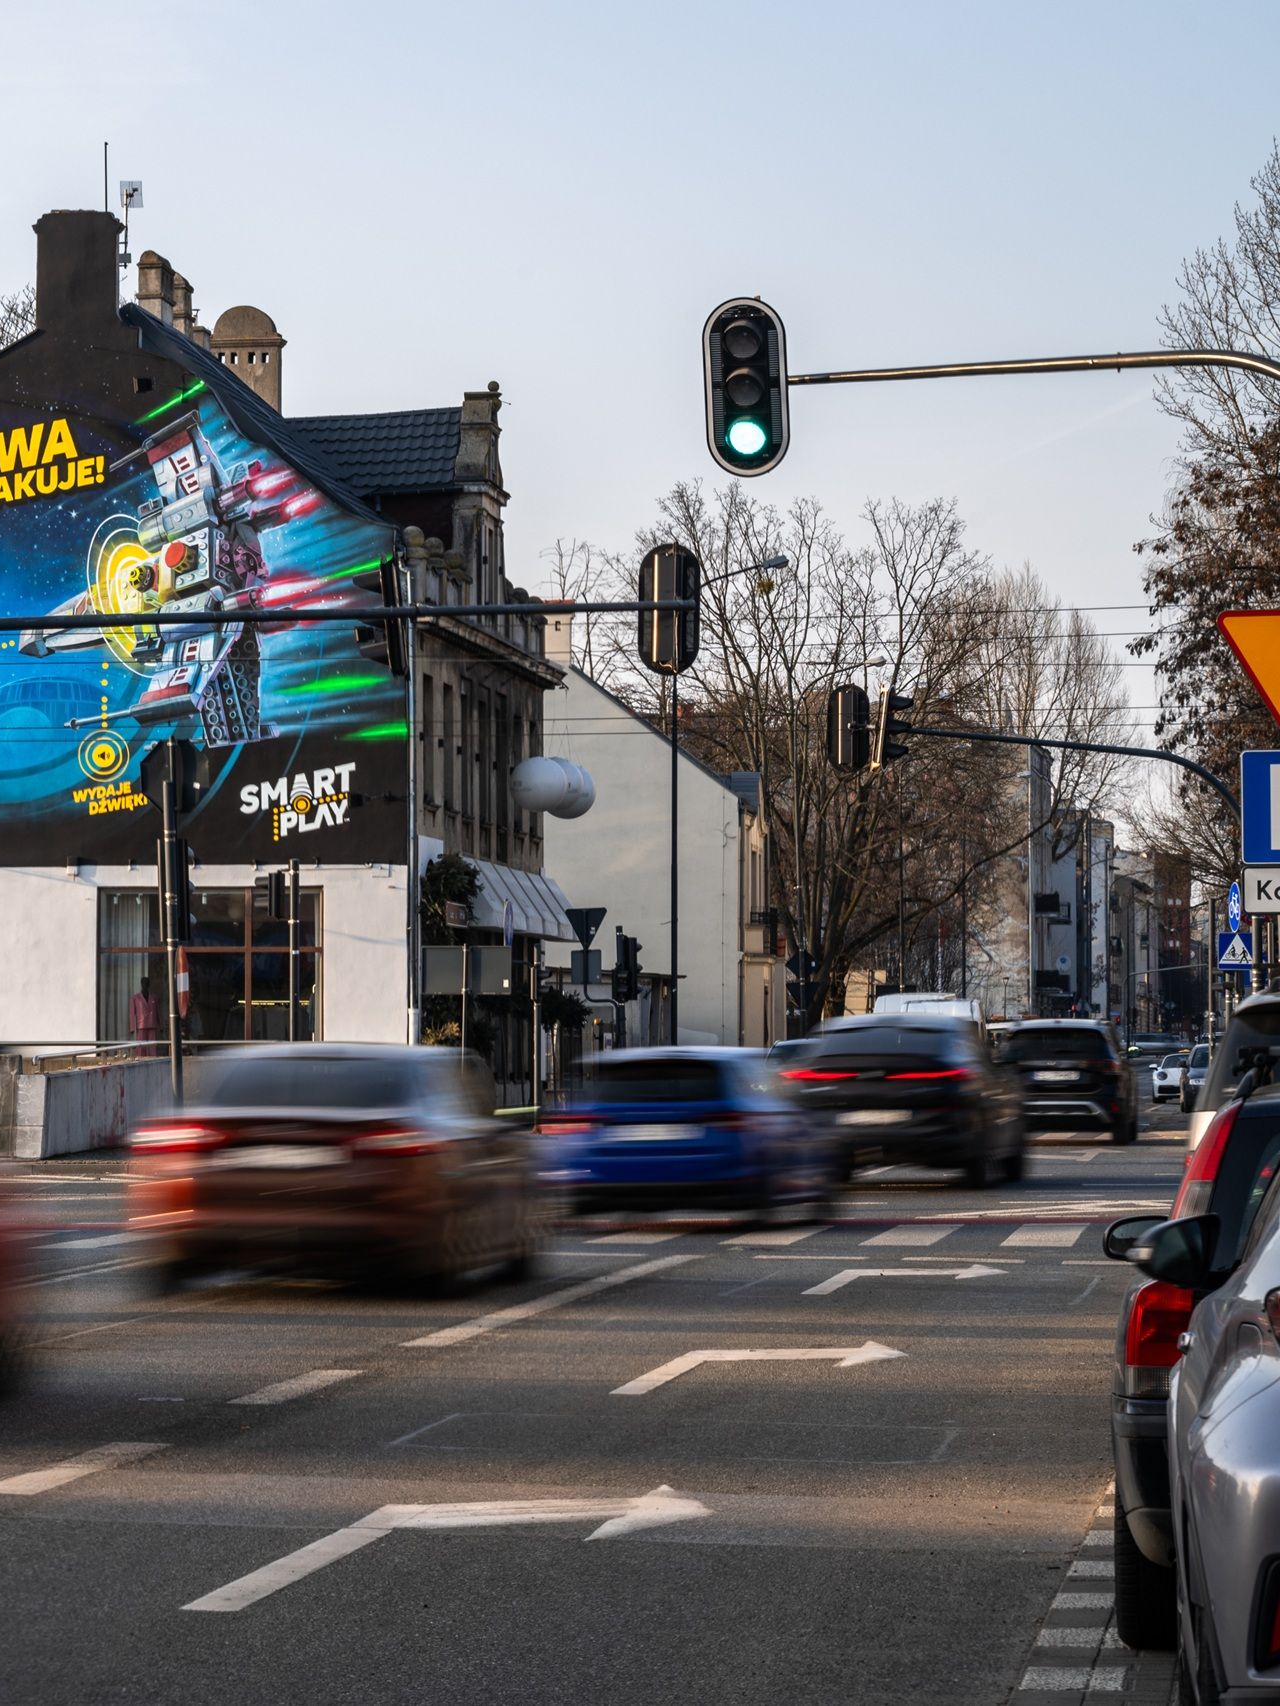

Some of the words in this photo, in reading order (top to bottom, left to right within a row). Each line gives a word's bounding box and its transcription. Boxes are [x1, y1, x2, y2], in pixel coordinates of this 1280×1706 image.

[73, 781, 132, 803] WYDAJE
[240, 762, 356, 814] SMART
[280, 799, 349, 837] PLAY
